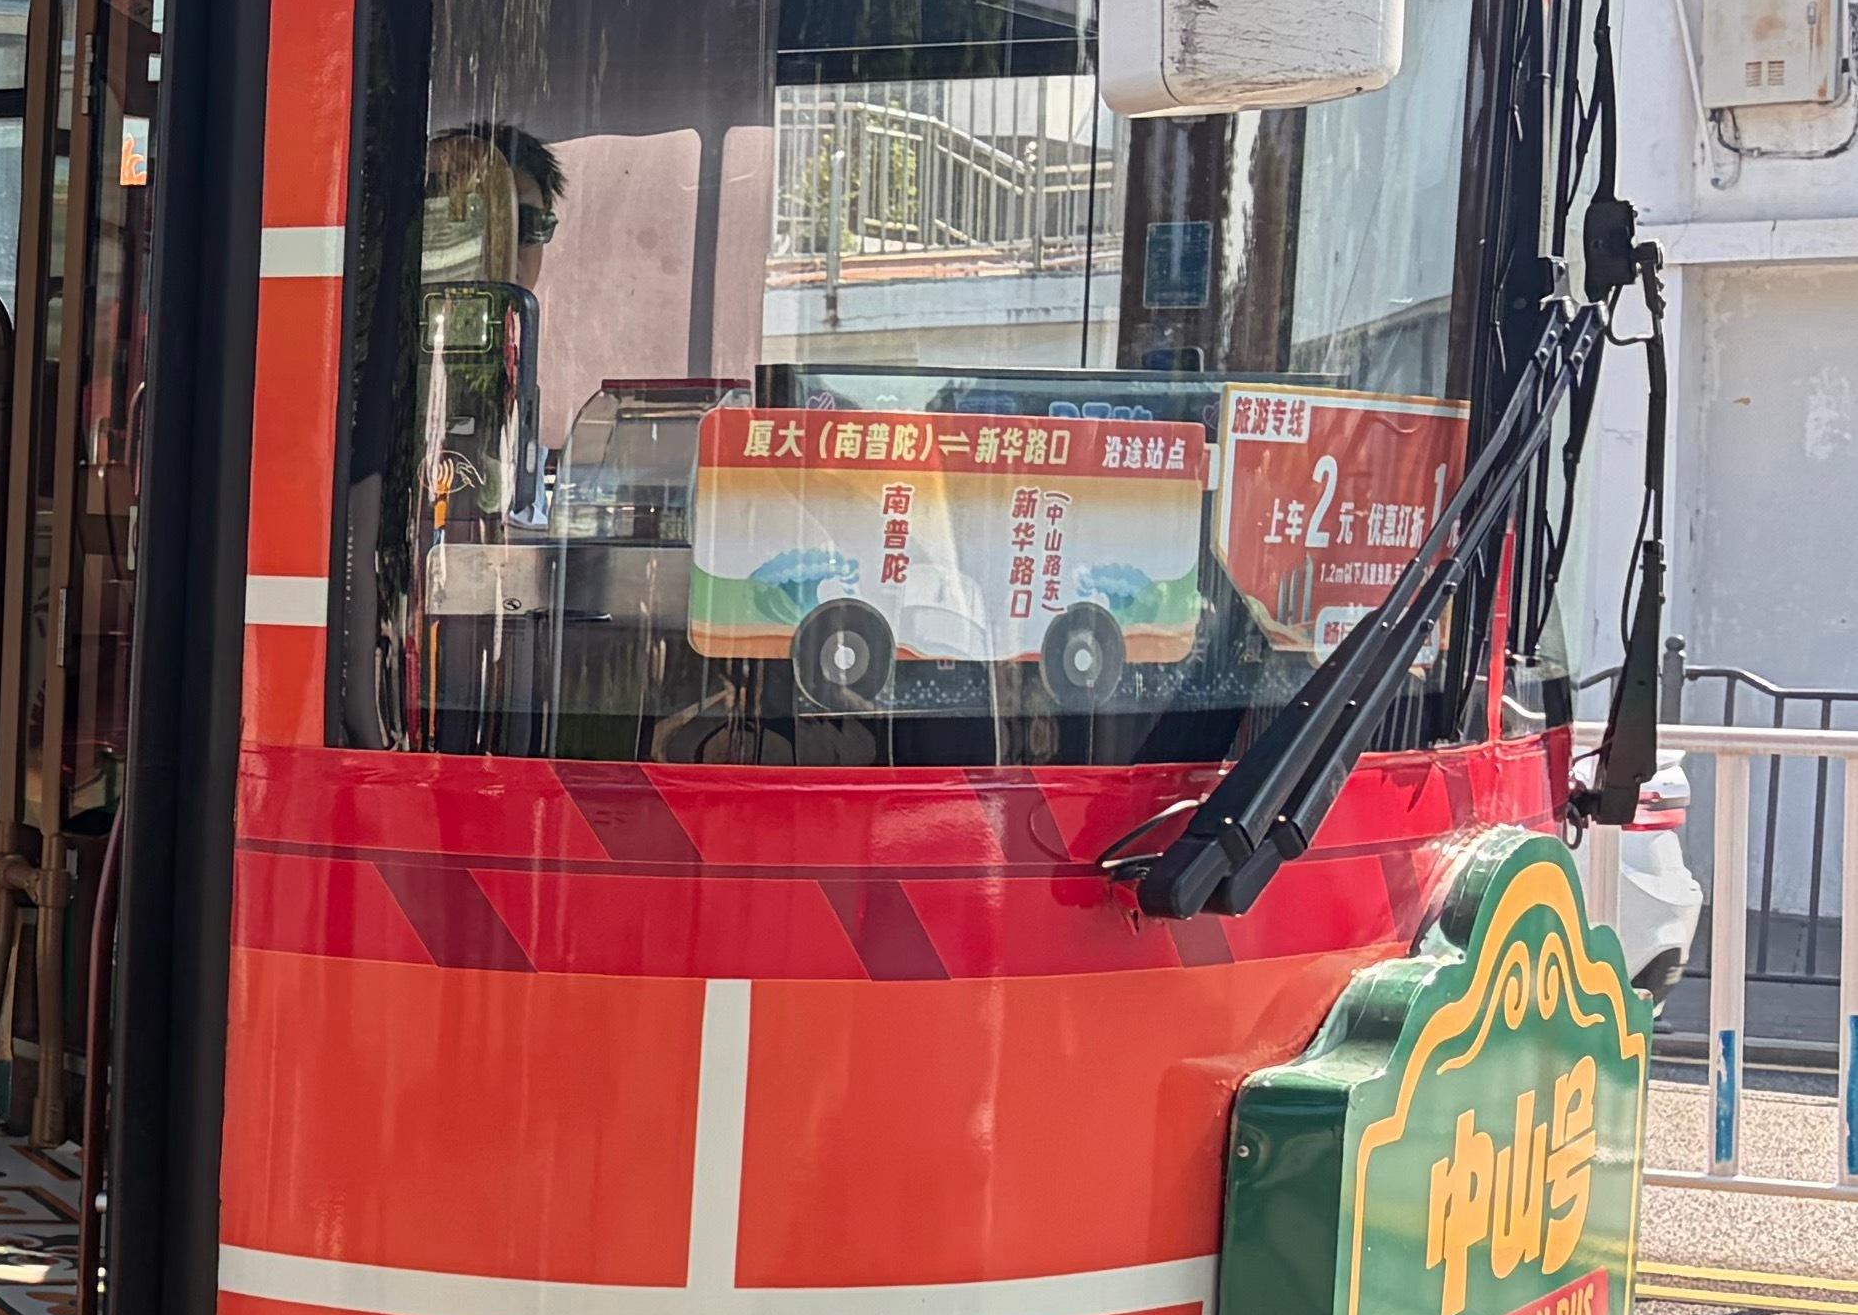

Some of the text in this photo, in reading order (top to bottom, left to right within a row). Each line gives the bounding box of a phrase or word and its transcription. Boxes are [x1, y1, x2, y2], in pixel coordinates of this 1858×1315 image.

[1231, 396, 1307, 437] 旅游专线
[1102, 435, 1187, 470] 沿途站点
[880, 482, 915, 584] 南普陀
[1009, 487, 1039, 620] 新华路口
